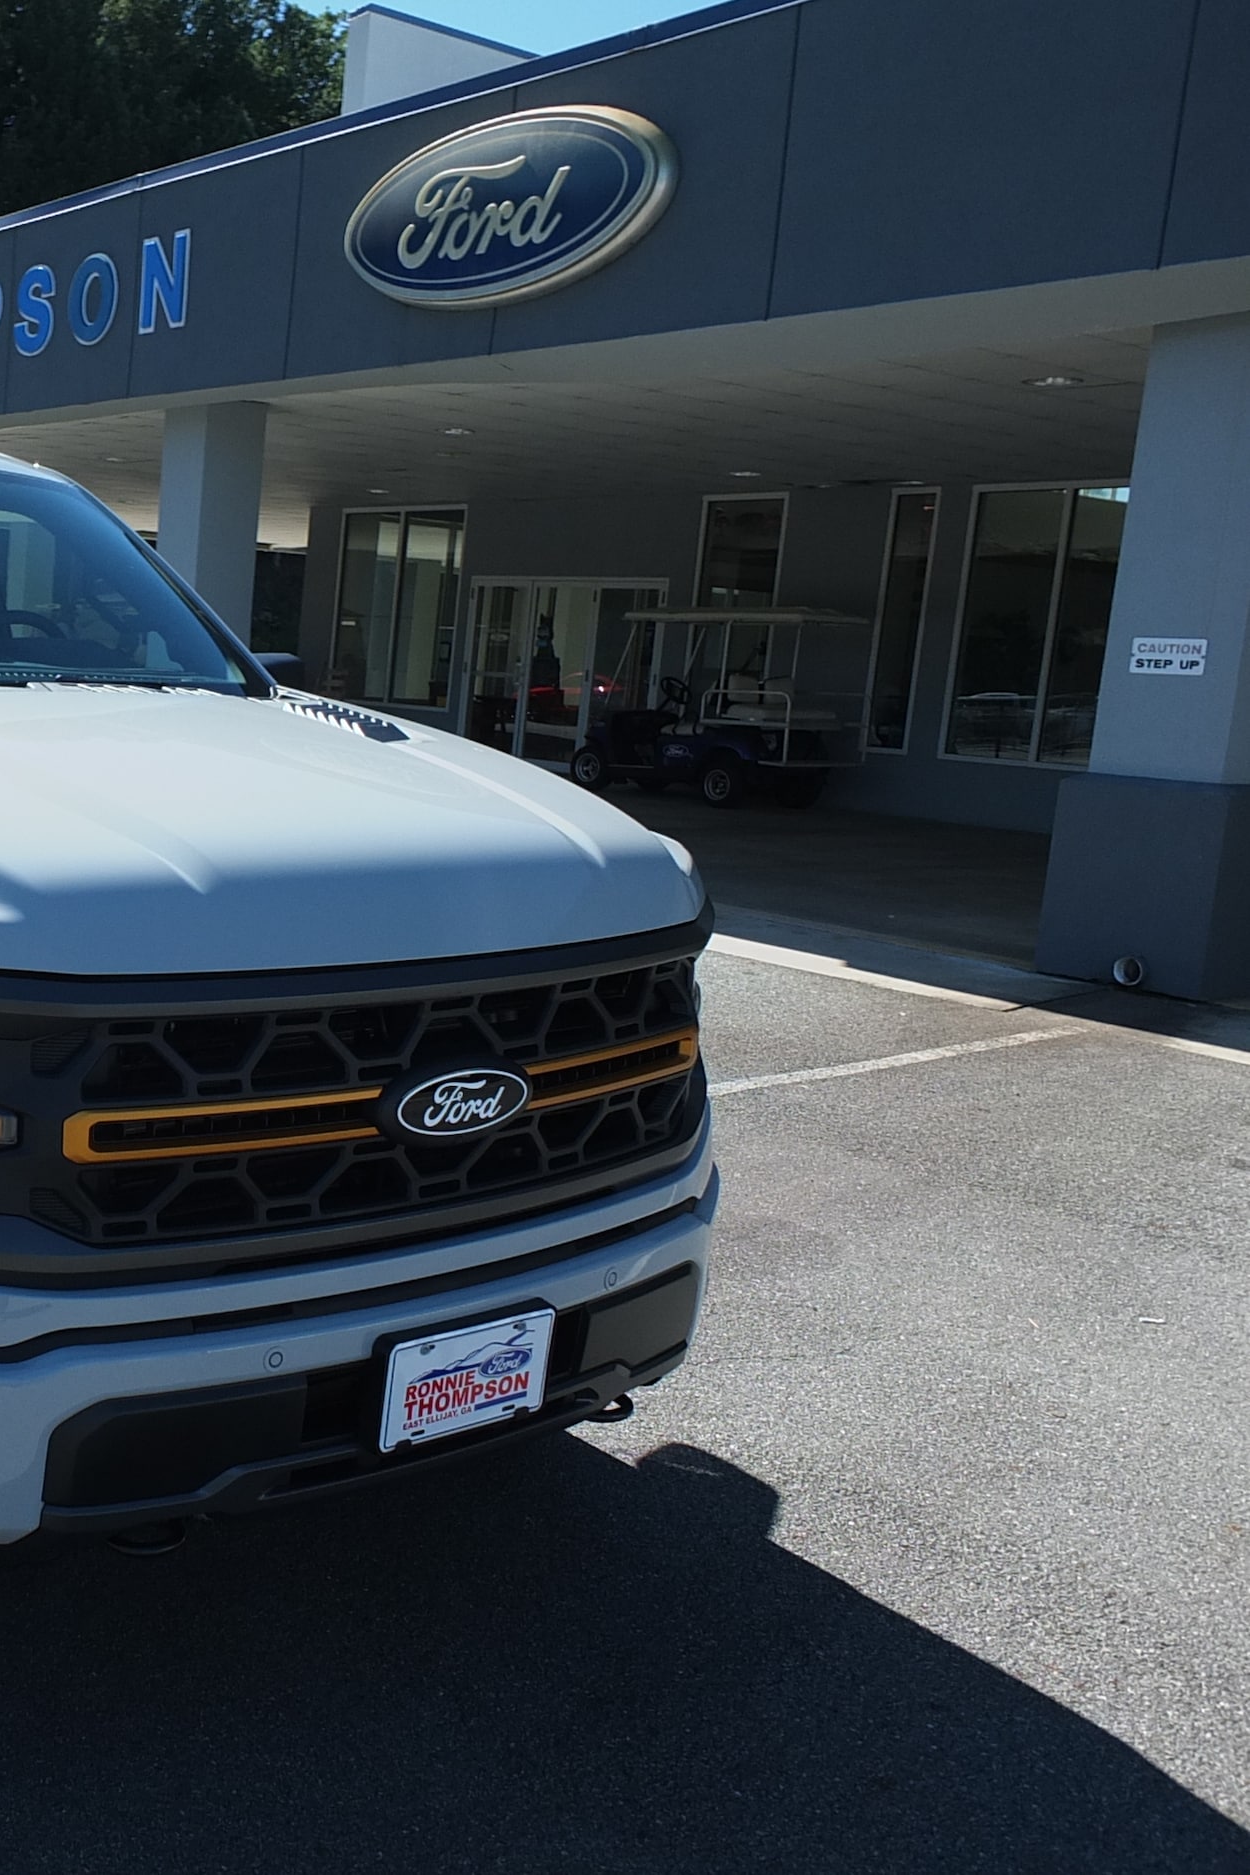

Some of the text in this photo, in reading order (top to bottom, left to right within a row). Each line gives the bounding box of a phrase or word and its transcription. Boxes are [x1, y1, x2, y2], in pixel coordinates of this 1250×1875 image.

[397, 154, 571, 270] Ford
[1137, 643, 1202, 655] CAUTION
[1134, 658, 1200, 670] STEP UP
[423, 1079, 506, 1128] Ford
[487, 1351, 522, 1374] Ford
[403, 1371, 530, 1421] THOMPSON
[405, 1369, 477, 1402] RONNIE
[402, 1418, 424, 1431] EAST
[460, 1405, 472, 1415] GA
